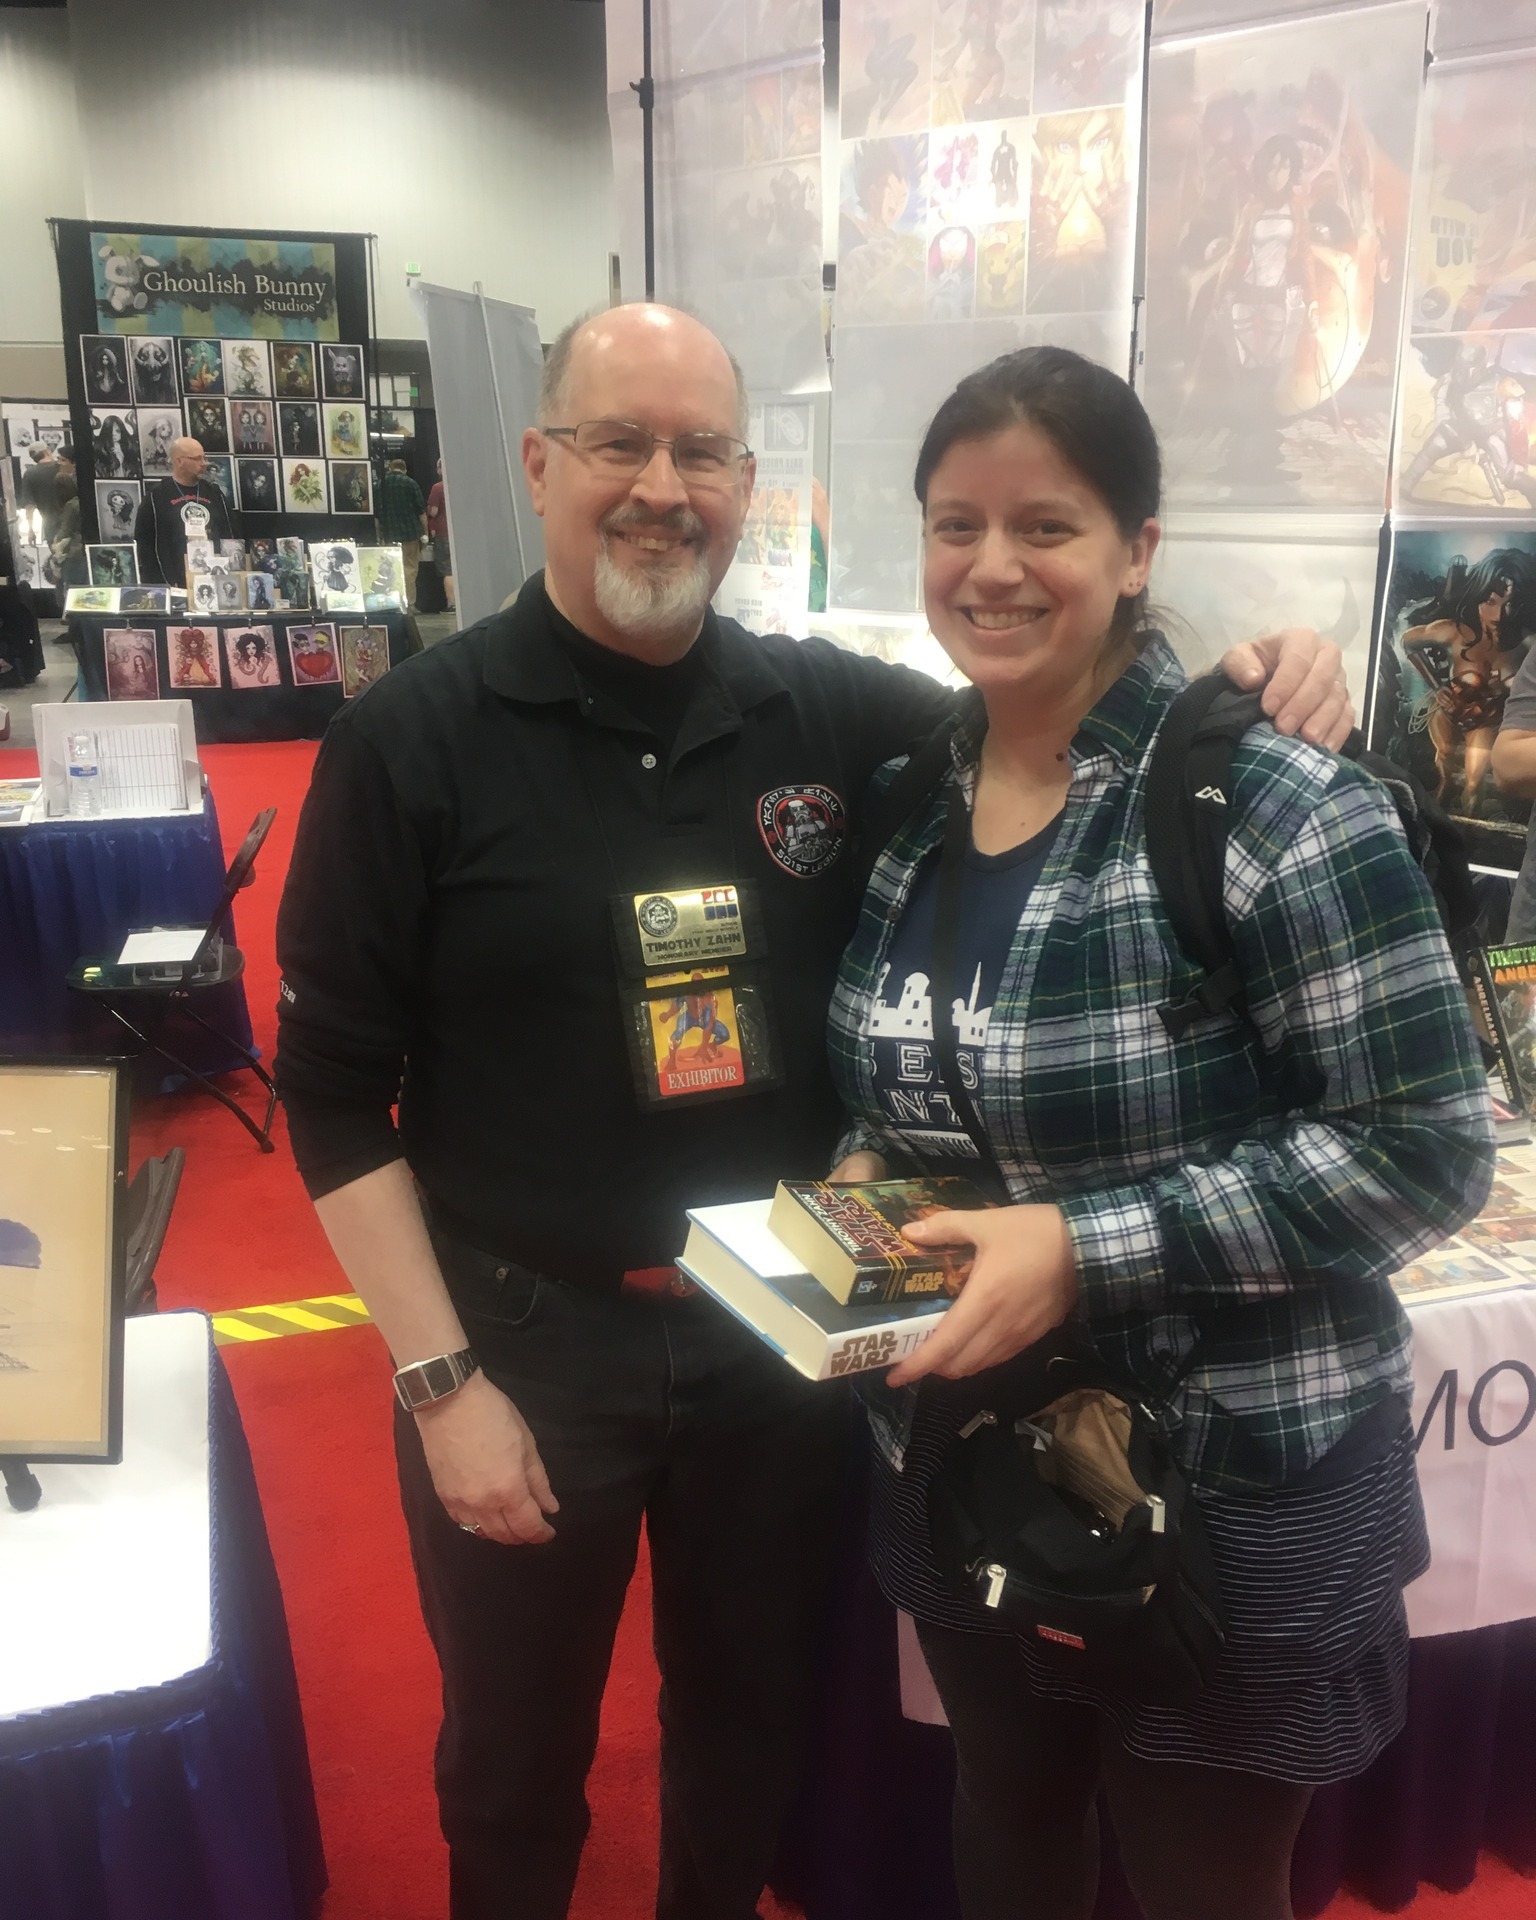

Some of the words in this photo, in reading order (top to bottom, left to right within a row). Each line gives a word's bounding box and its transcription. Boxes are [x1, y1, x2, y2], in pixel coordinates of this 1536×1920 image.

[143, 270, 247, 295] Ghoulish
[254, 274, 327, 304] Bunny
[263, 298, 315, 312] Studios
[776, 848, 809, 873] 501ST
[811, 836, 842, 873] LEGION
[645, 937, 701, 953] TIMOTHY
[706, 933, 742, 946] ZAHN
[667, 1065, 738, 1090] EXHIBITOR
[801, 1203, 829, 1228] ZAHN
[812, 1190, 889, 1254] STAR
[830, 1190, 907, 1254] WARS
[824, 1226, 863, 1253] TIMOTHY
[904, 1280, 940, 1293] WARS
[912, 1271, 945, 1283] STAR
[831, 1330, 898, 1358] STAR
[902, 1328, 936, 1354] TH
[830, 1346, 897, 1376] WARS
